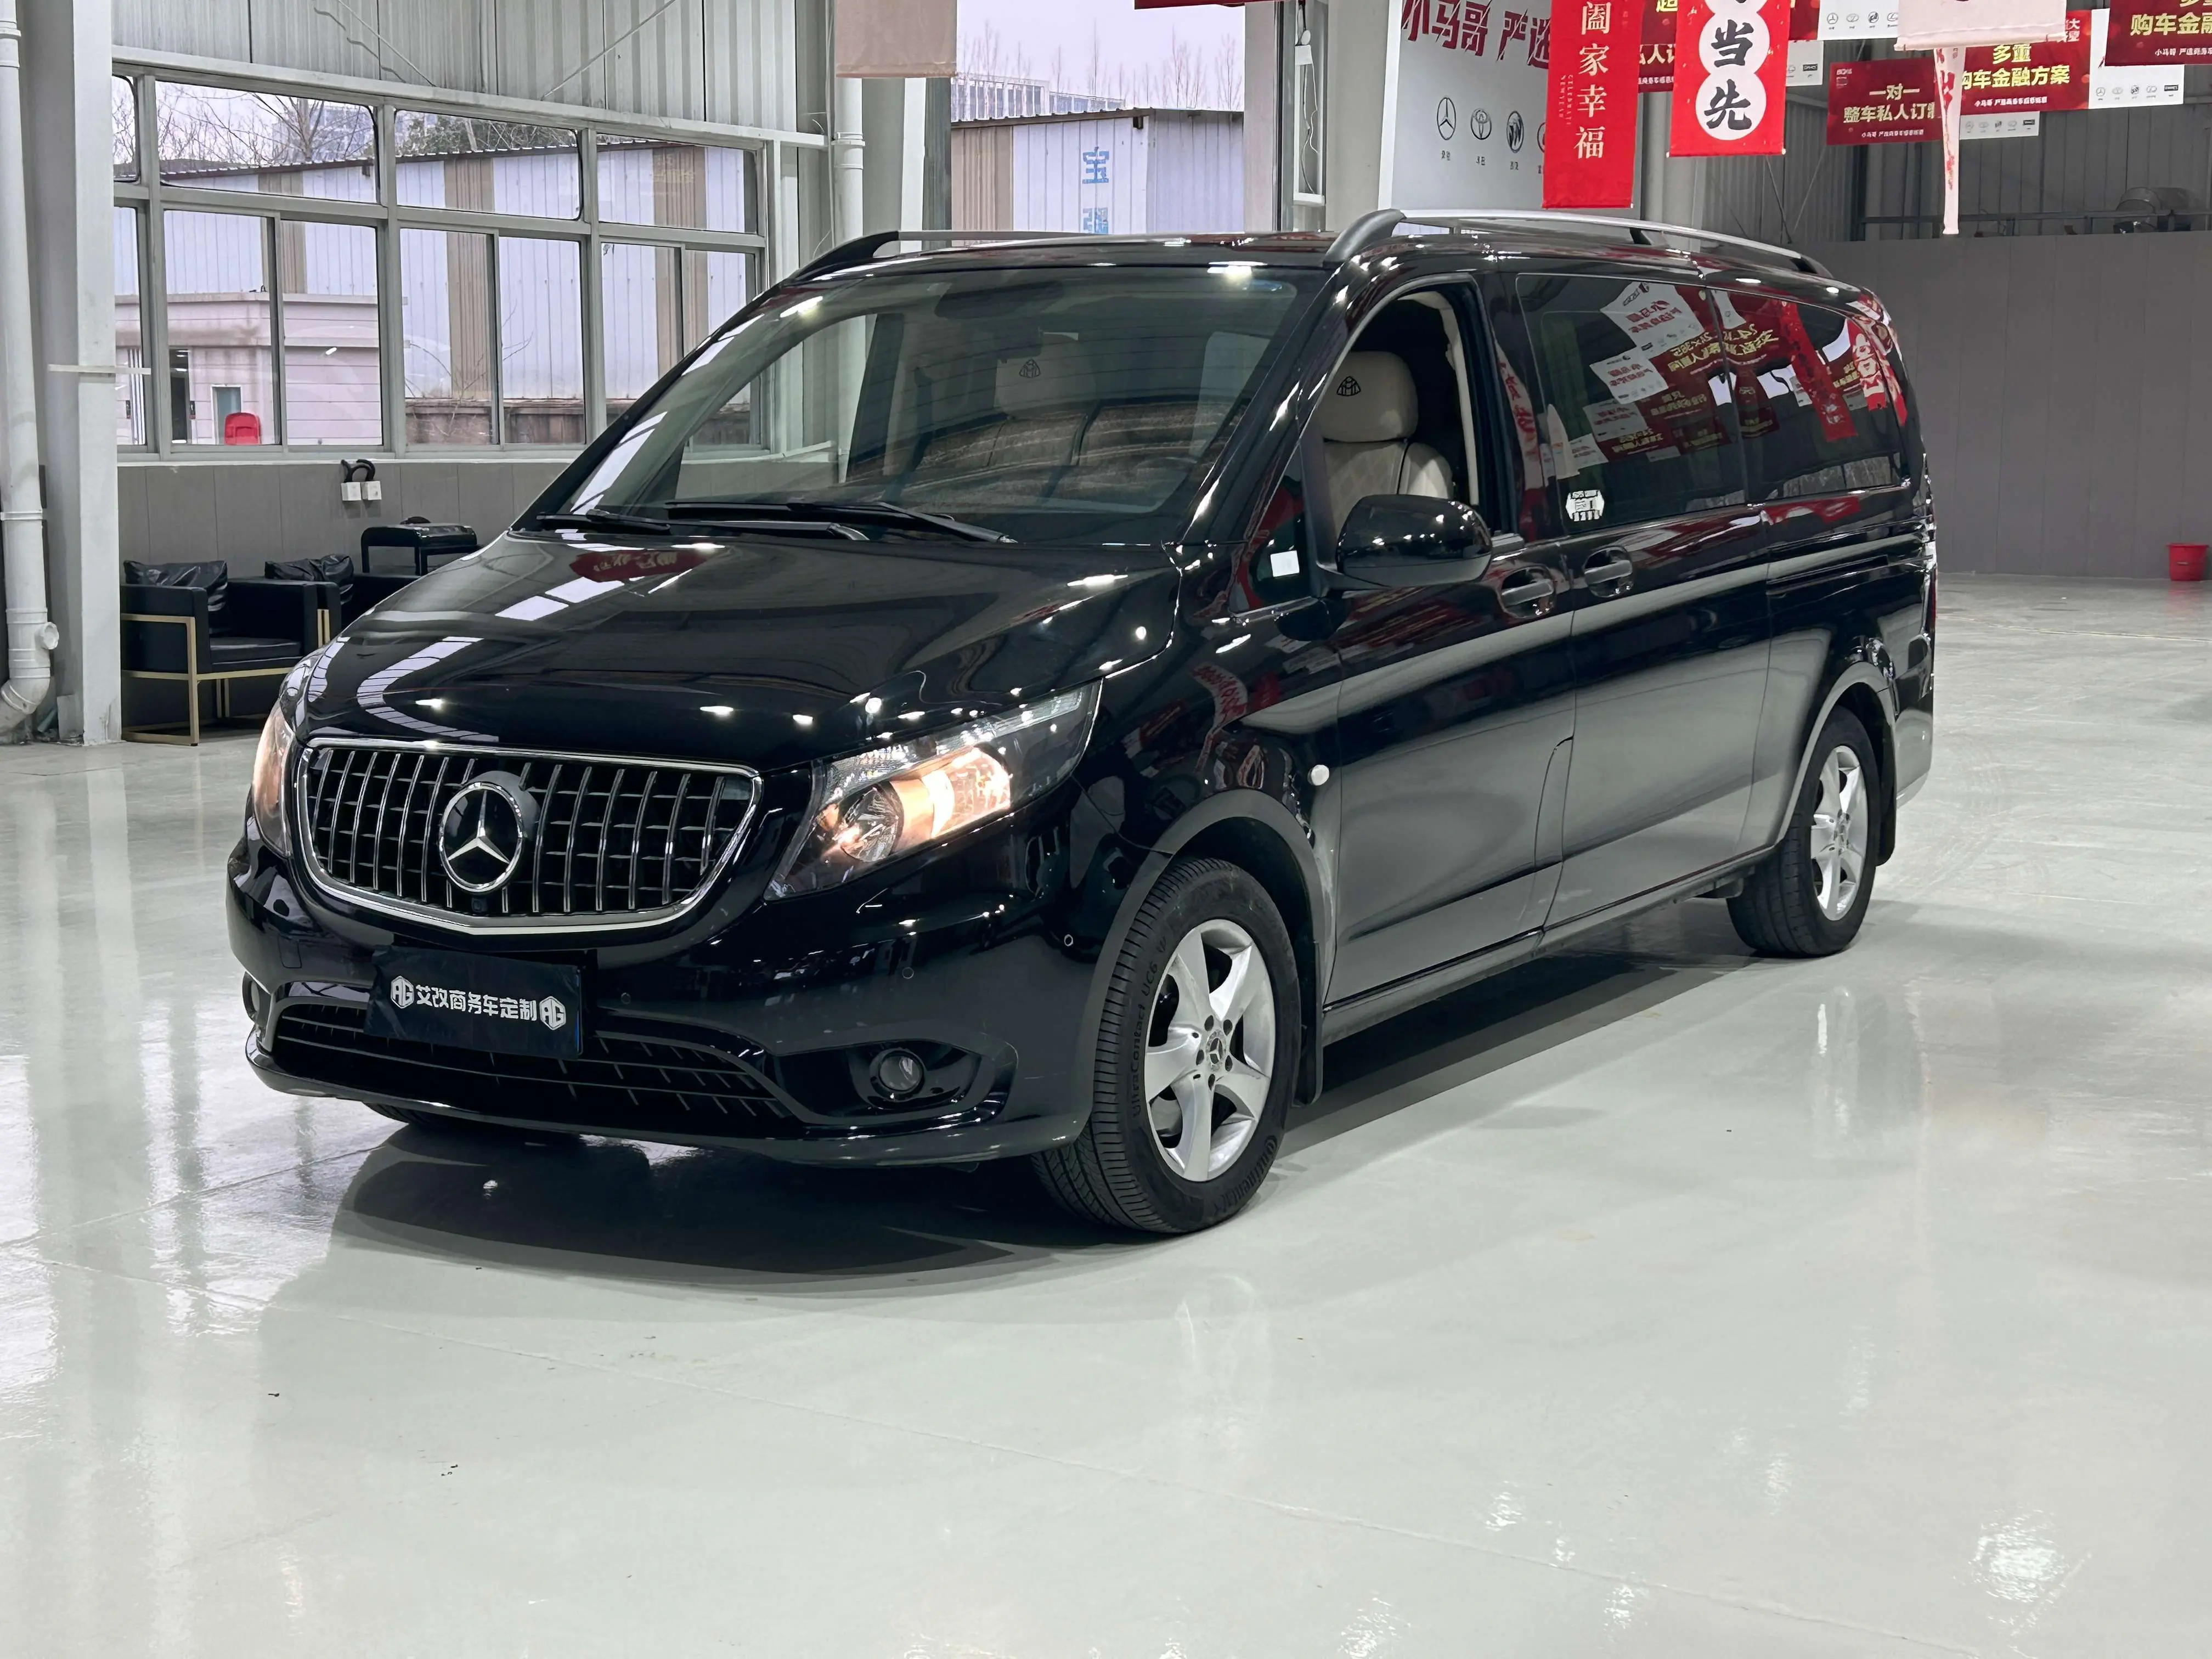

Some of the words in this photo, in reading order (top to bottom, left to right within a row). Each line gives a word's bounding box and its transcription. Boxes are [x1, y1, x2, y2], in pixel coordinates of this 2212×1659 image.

[1573, 2, 1612, 159] 阖家幸福
[1704, 0, 1754, 131] 当先
[1869, 83, 1920, 100] 一对一
[415, 984, 537, 1022] 艾改商务车定制
